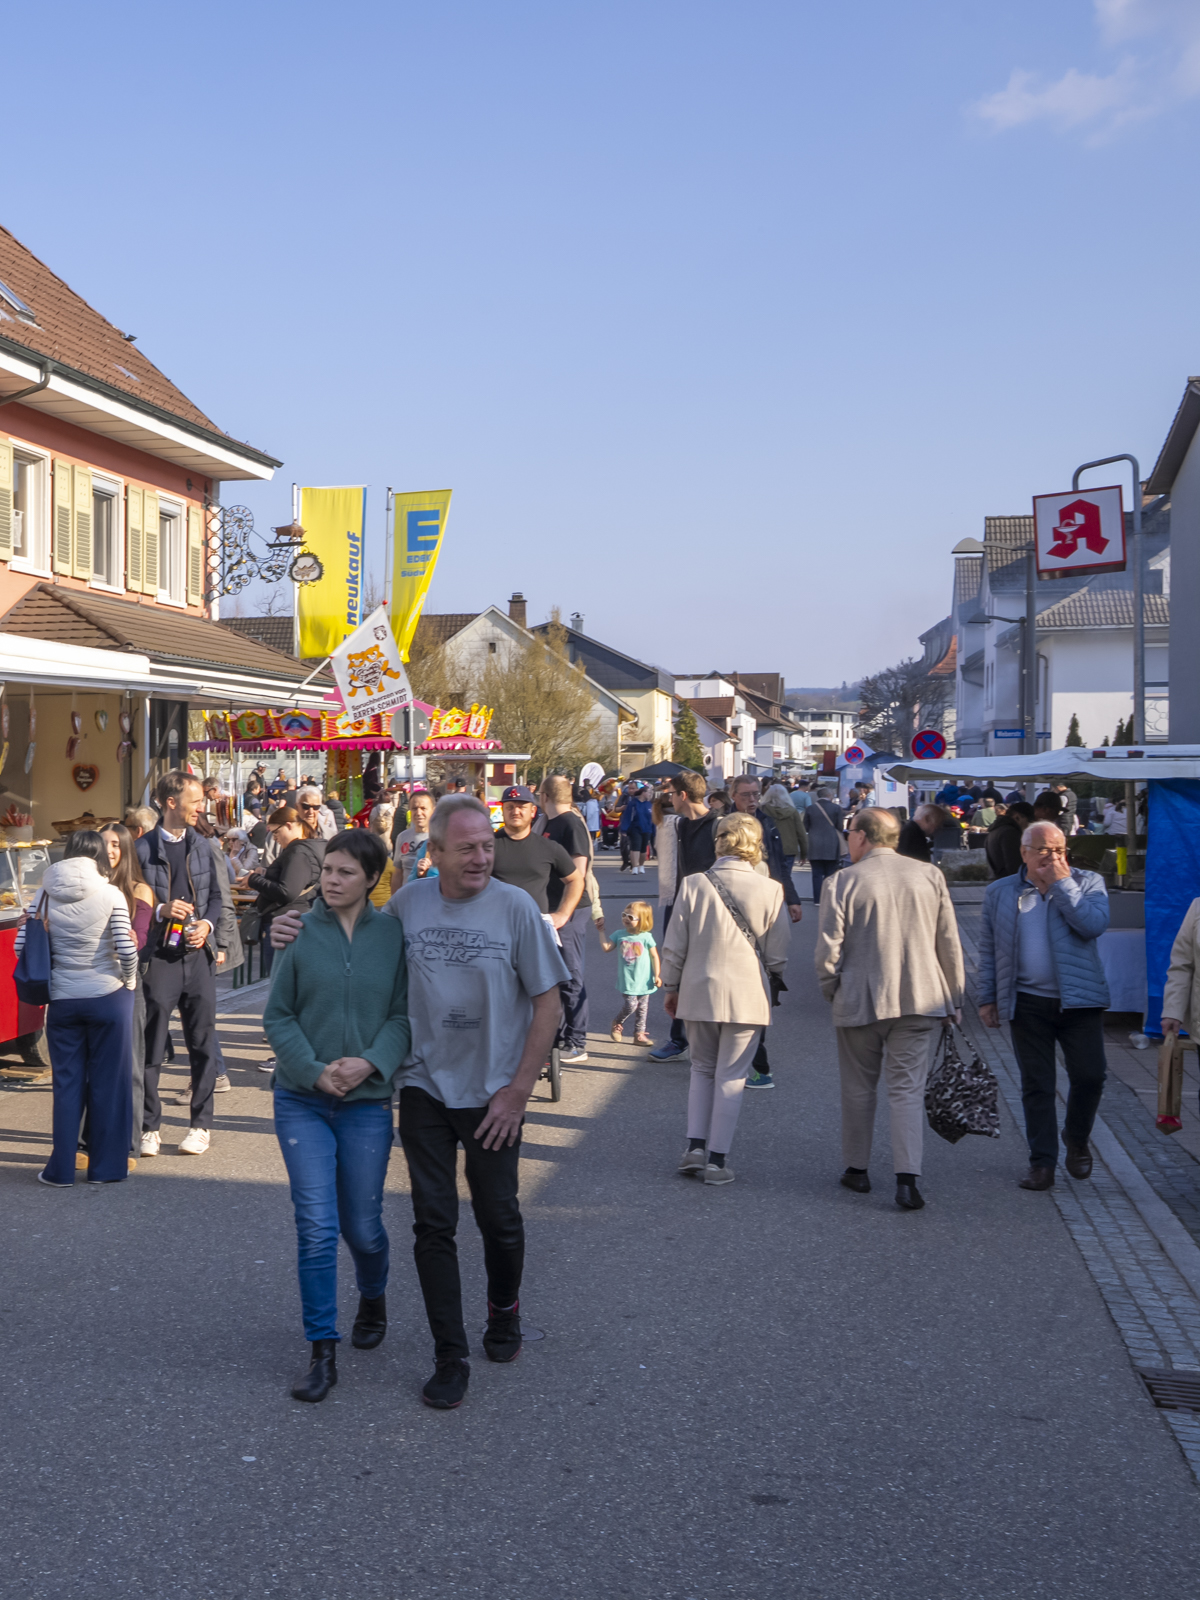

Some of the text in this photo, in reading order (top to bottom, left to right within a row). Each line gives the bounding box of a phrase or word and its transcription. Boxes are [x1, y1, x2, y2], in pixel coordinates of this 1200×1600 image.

[406, 554, 431, 564] EDEK
[346, 531, 360, 626] neukauf
[351, 692, 395, 712] Spruchherzen
